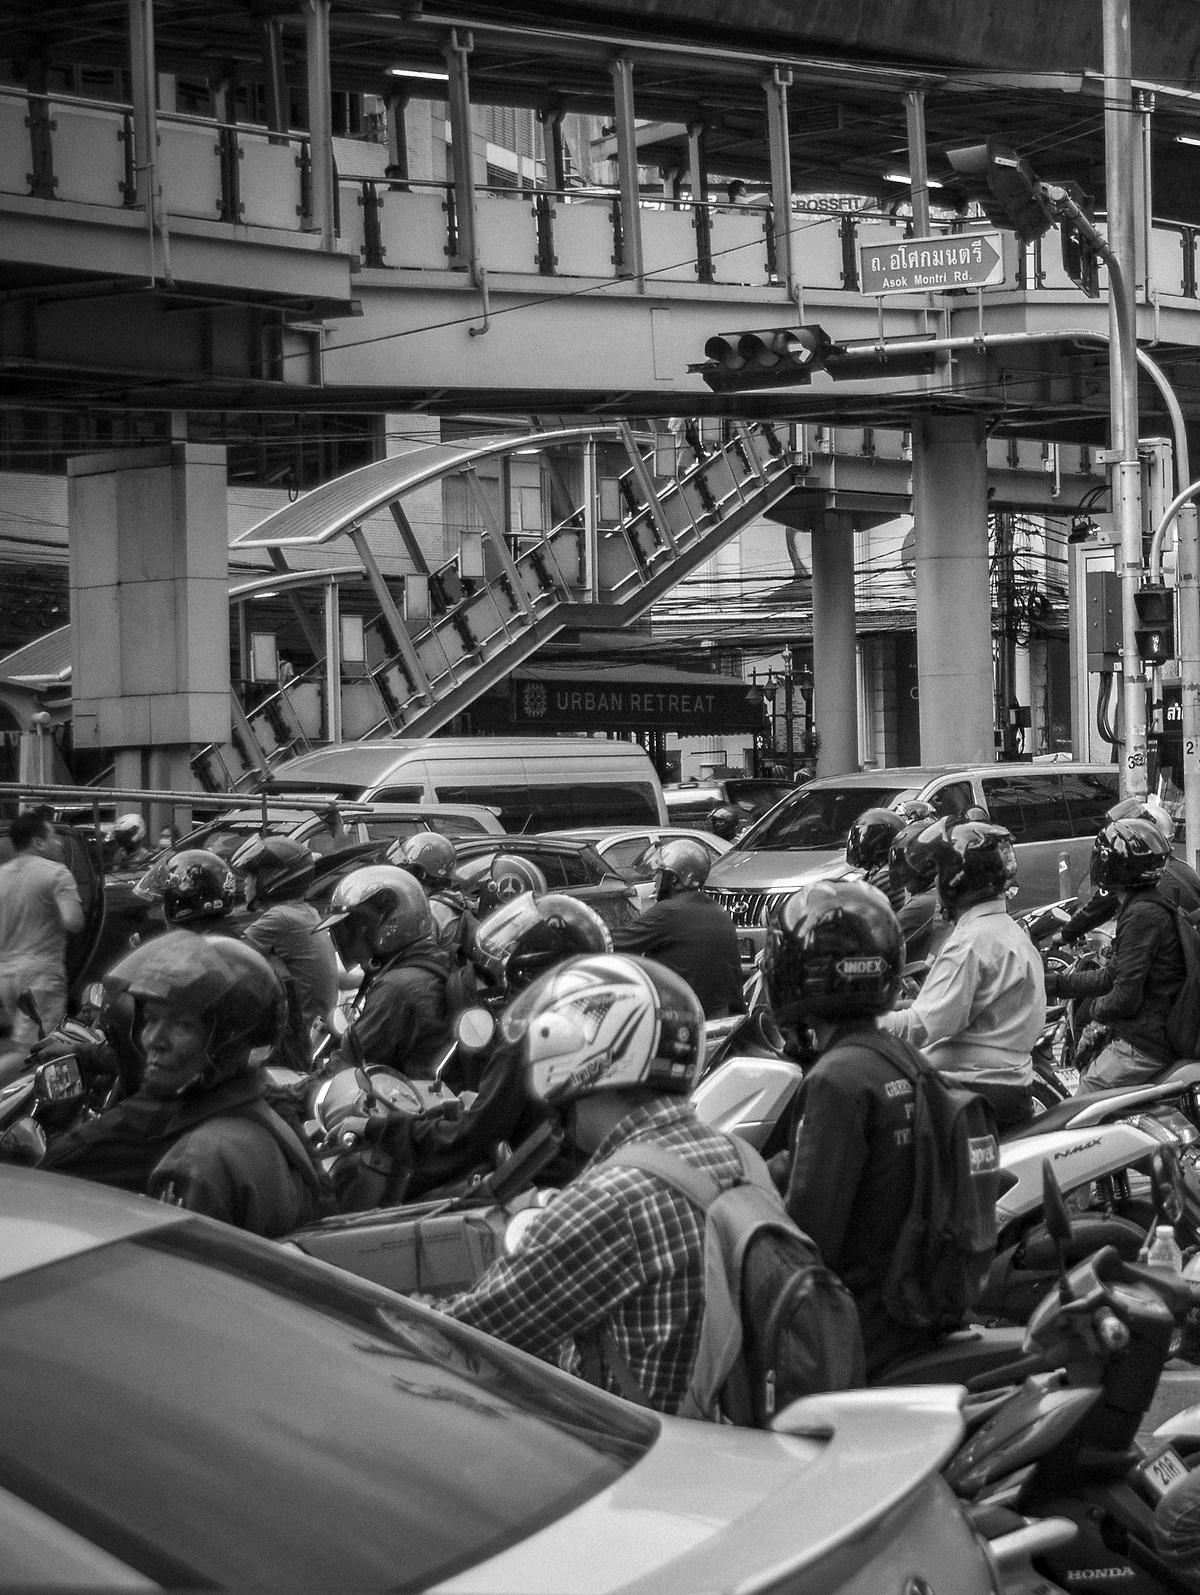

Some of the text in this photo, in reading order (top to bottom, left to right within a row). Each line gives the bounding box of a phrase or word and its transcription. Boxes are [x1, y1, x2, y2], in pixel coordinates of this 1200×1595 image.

[871, 240, 982, 272] ถ. อโศกมนตรี
[882, 270, 972, 289] Asok Montri Rd.
[556, 691, 716, 713] URBAN RETREAT
[1185, 741, 1195, 755] 2
[1127, 755, 1136, 769] 3
[844, 960, 882, 973] INDEX
[1066, 1566, 1136, 1580] HONDA
